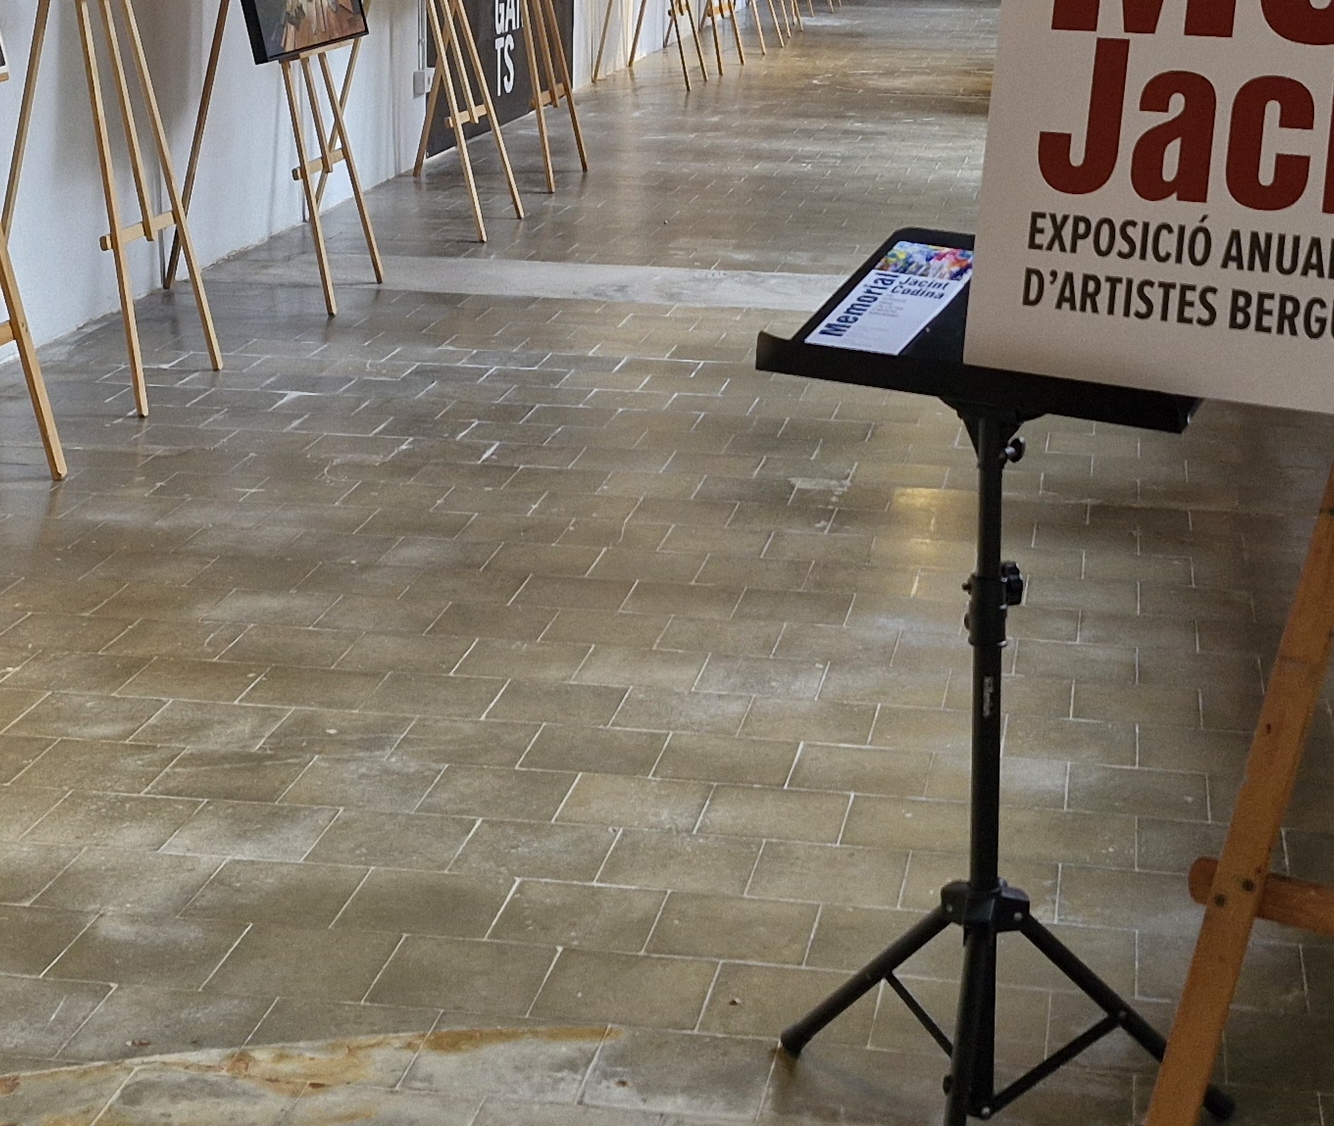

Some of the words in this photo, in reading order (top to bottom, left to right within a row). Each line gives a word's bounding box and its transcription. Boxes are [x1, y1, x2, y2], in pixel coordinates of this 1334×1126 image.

[495, 34, 515, 97] TS
[1027, 211, 1212, 267] EXPOSICIÓ
[819, 272, 899, 337] Memorial
[890, 284, 945, 300] Codina
[898, 276, 950, 291] Jacint
[1022, 267, 1219, 327] D’ARTISTES
